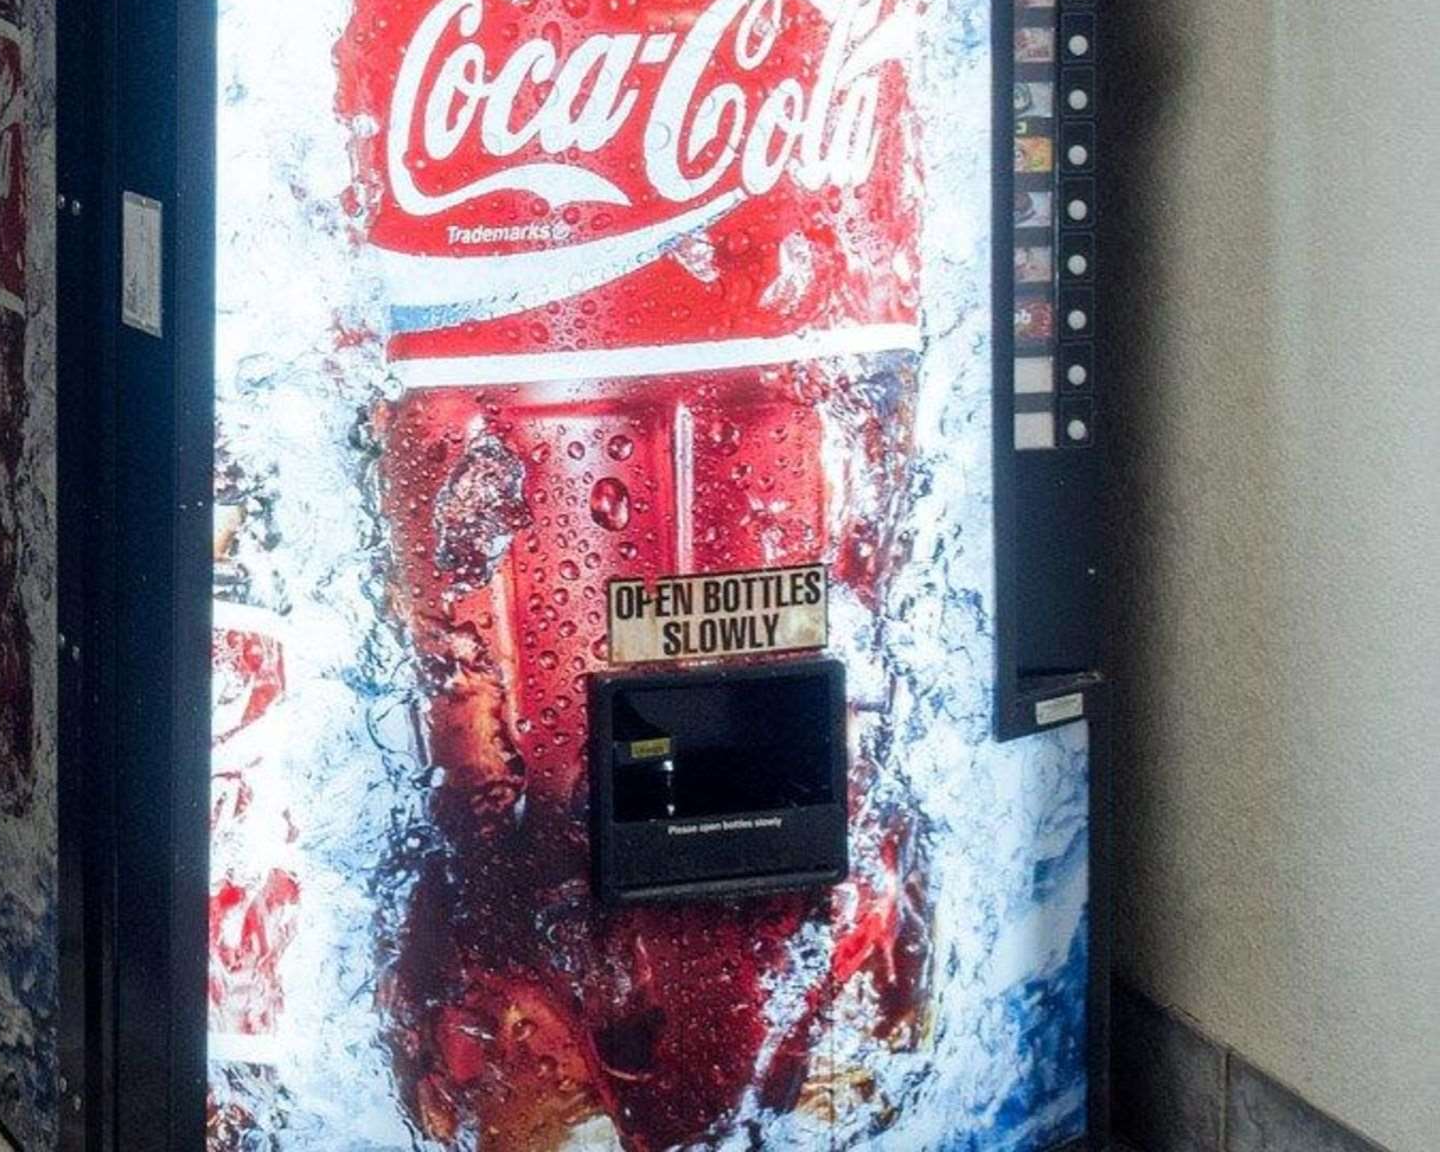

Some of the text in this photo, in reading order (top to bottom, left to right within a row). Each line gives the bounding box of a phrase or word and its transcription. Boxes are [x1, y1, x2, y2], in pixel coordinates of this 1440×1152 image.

[704, 571, 821, 614] BOTTLES
[663, 614, 779, 656] SLOWLY
[667, 816, 782, 836] Please open bottles slowly
